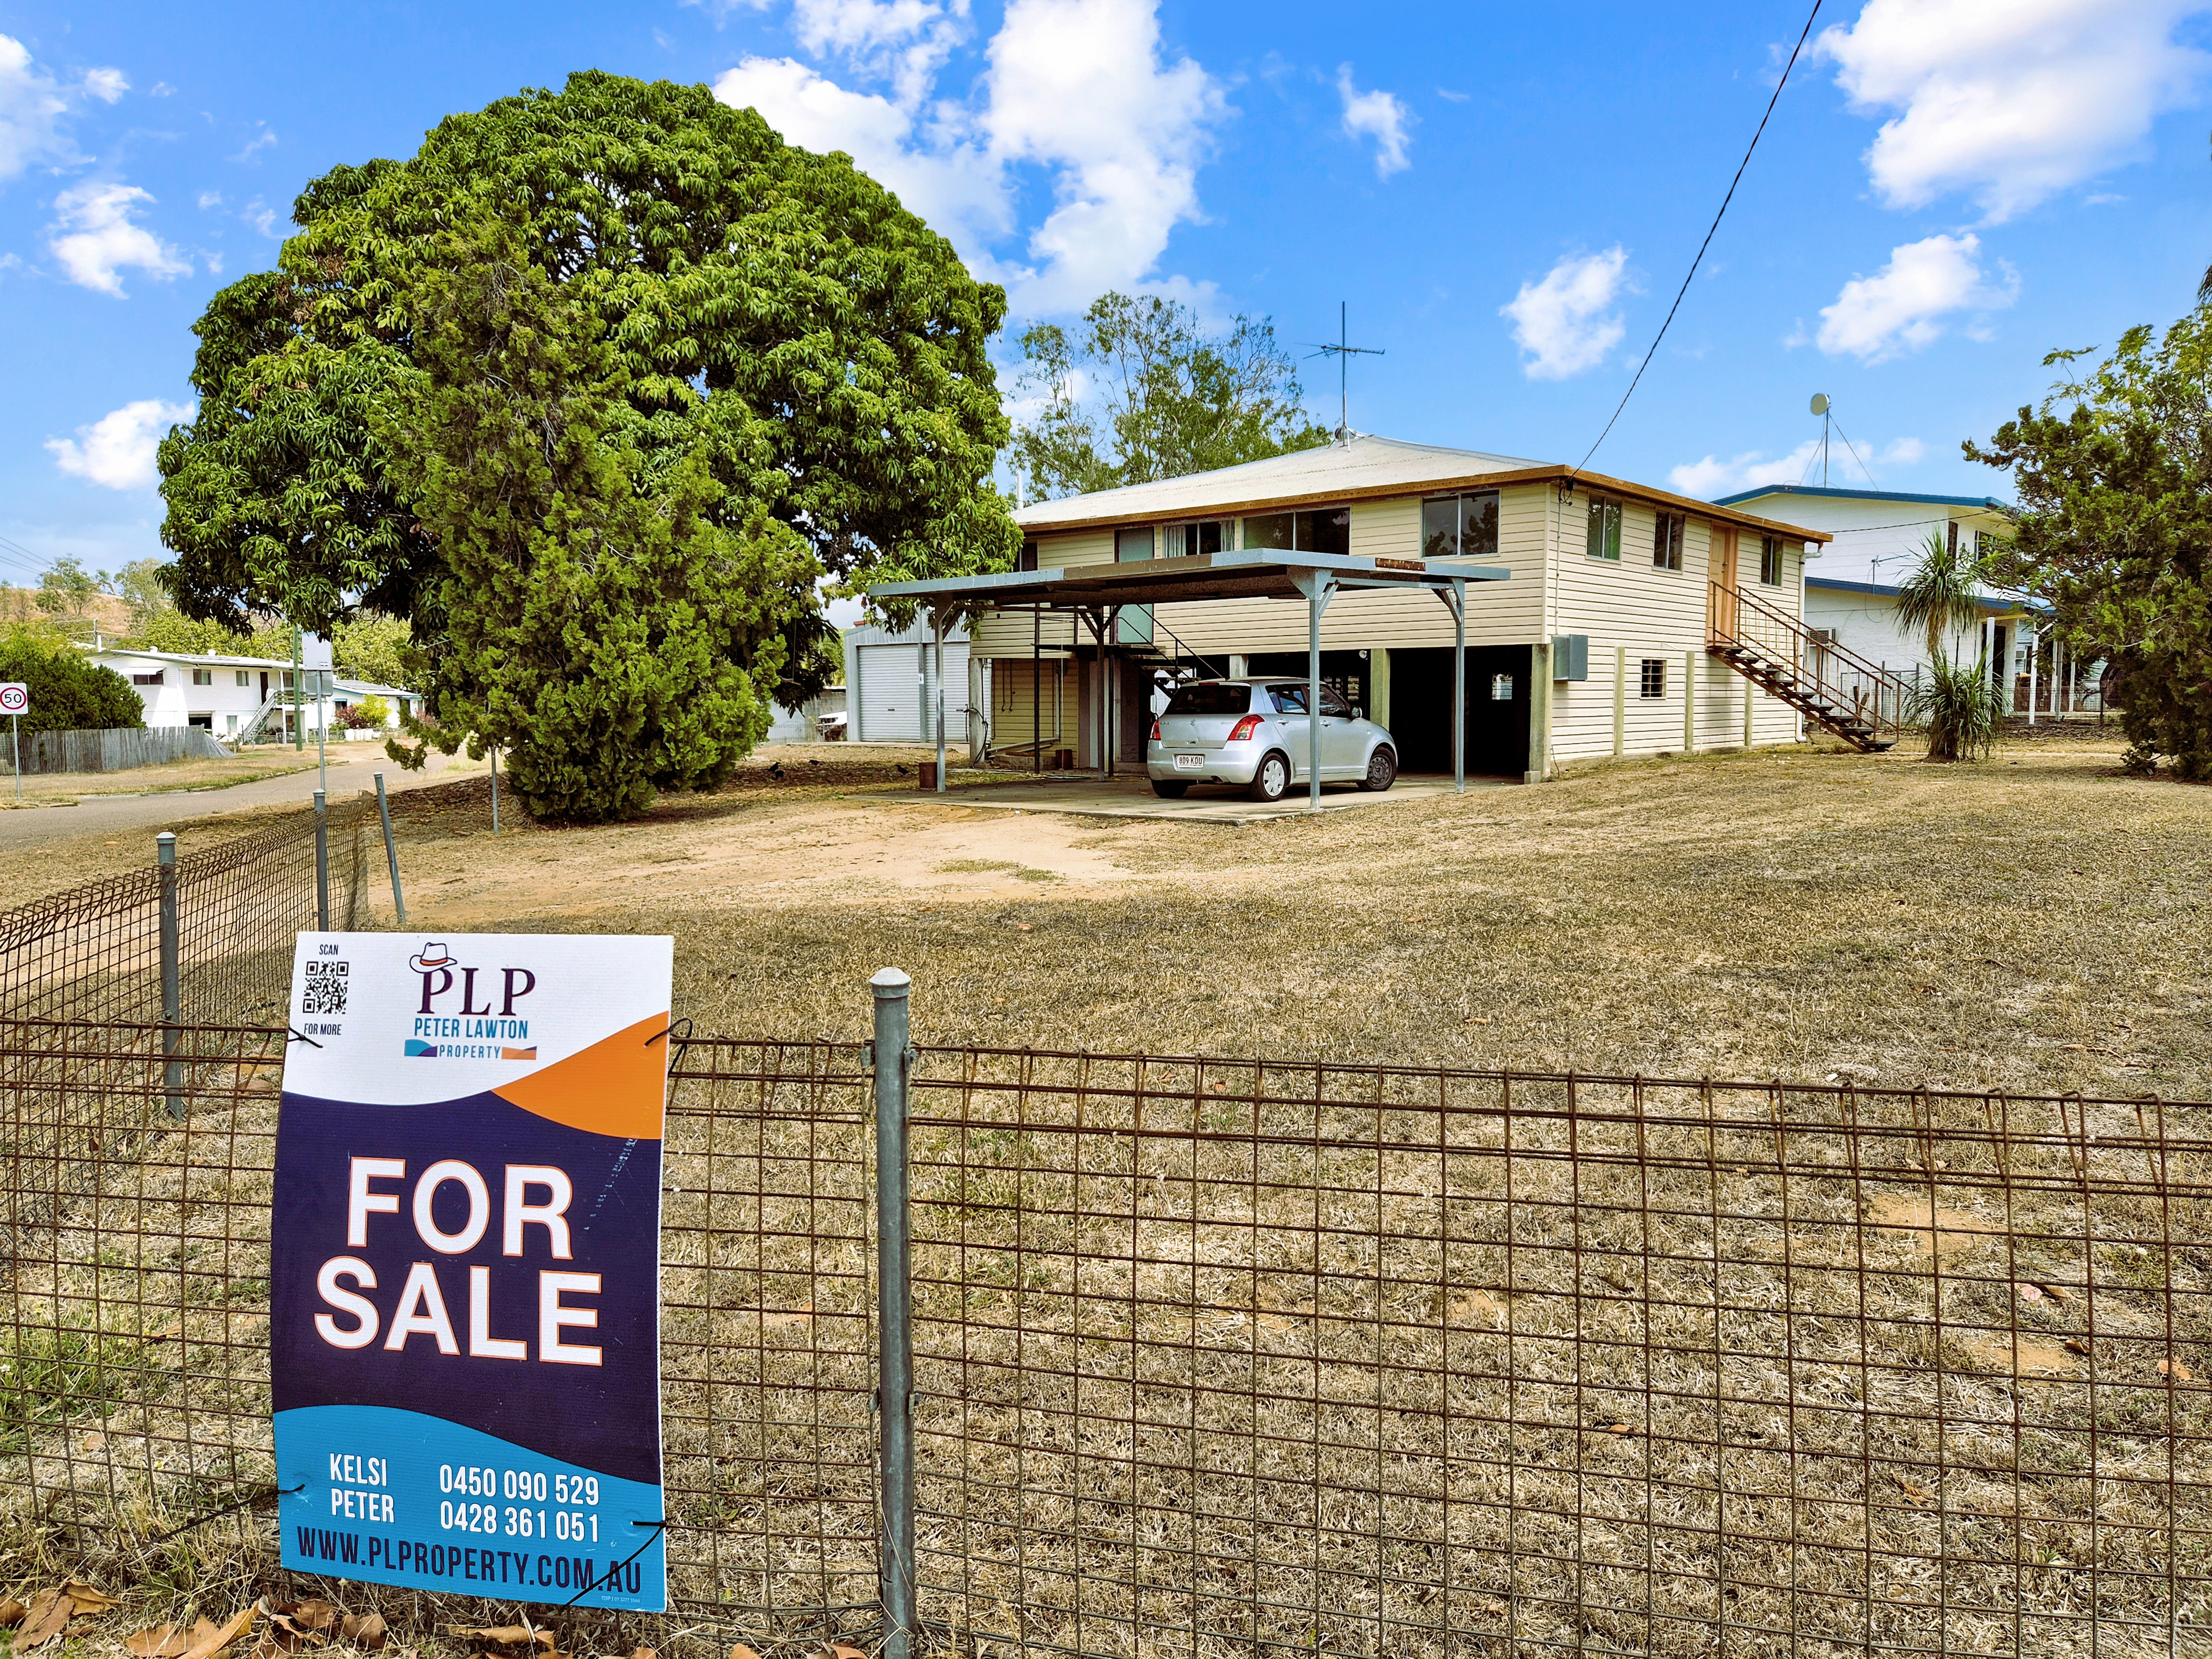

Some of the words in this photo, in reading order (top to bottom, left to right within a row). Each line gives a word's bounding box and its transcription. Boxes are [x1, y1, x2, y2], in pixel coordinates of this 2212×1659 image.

[4, 693, 22, 703] 50
[319, 944, 338, 956] SCAN
[416, 967, 535, 1016] PLP
[304, 1023, 318, 1035] FOR
[320, 1024, 342, 1035] MORE
[414, 1018, 460, 1037] PETER
[465, 1019, 528, 1039] LAWTON
[439, 1044, 501, 1059] PROPERTY
[347, 1156, 573, 1260] FOR
[314, 1255, 602, 1366] SALE
[330, 1453, 387, 1486] KELSI
[440, 1464, 497, 1497] 0450
[504, 1470, 547, 1501] 090
[555, 1474, 599, 1505] 529
[331, 1488, 395, 1524] PETER
[440, 1500, 497, 1534] 0428
[504, 1506, 546, 1538] 361
[556, 1511, 598, 1542] 051
[297, 1526, 641, 1594] WWW.PLPROPERTY.COM.AU
